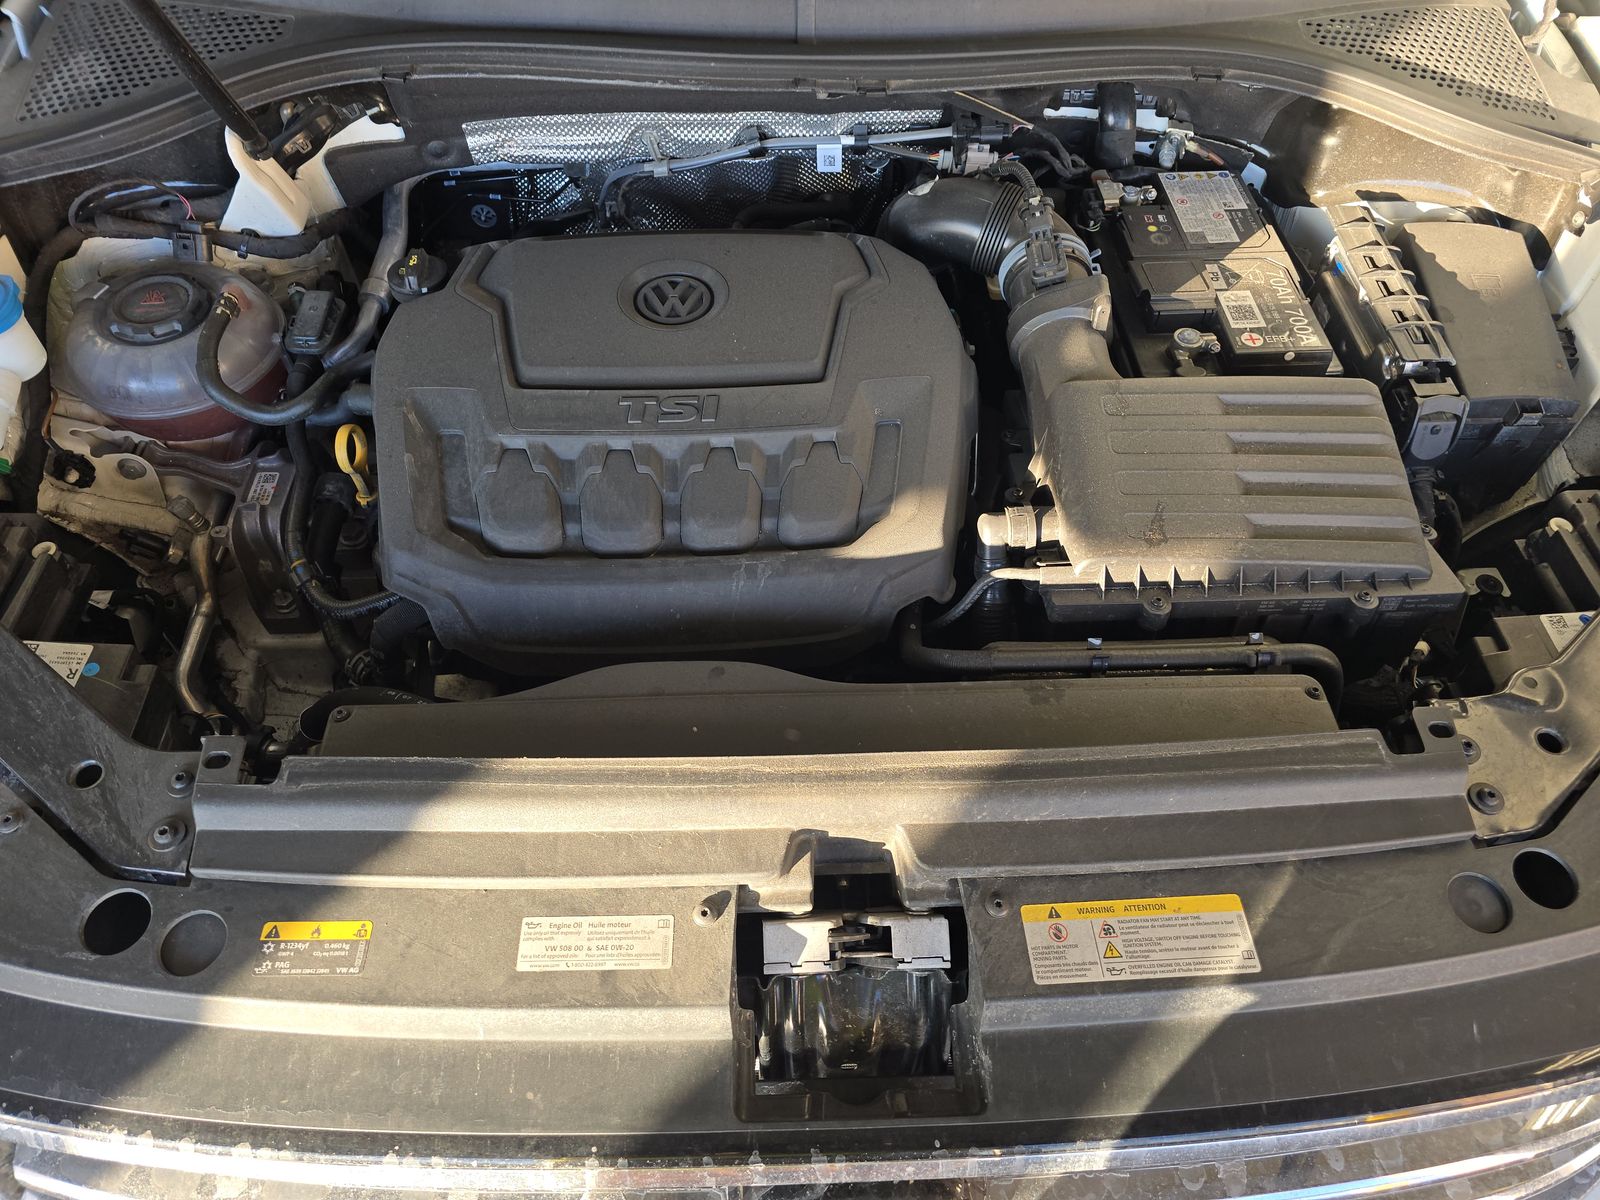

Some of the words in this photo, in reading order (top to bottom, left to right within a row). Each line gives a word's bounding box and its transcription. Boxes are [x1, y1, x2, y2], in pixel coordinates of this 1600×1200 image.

[1209, 272, 1219, 282] Pb
[1265, 270, 1296, 304] 70Ah
[1284, 308, 1318, 346] 700A
[618, 395, 720, 424] TSI
[66, 668, 78, 679] R
[1077, 906, 1115, 915] WARNING
[1123, 903, 1167, 912] ATTENTION
